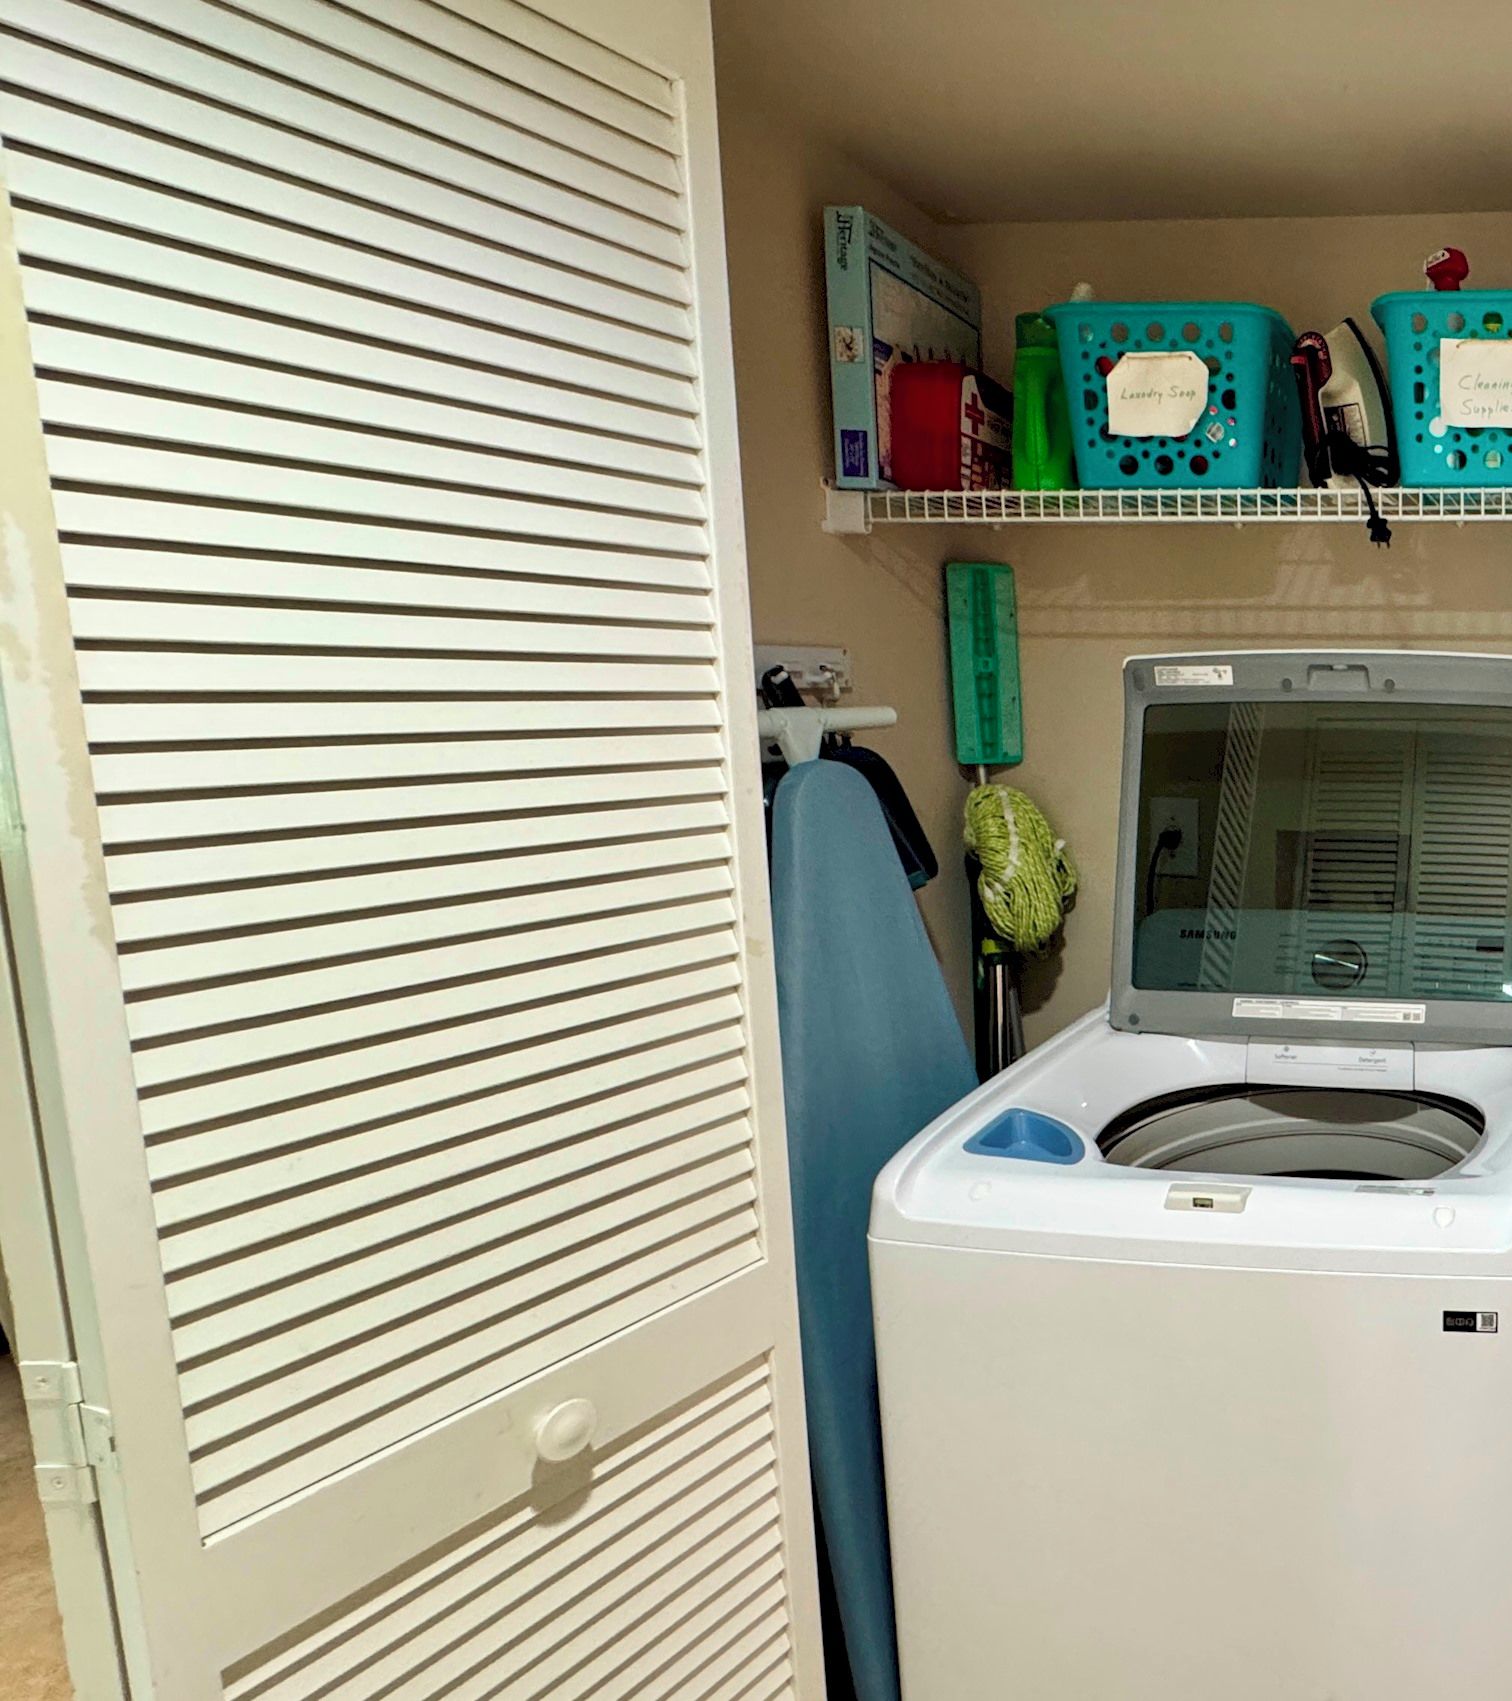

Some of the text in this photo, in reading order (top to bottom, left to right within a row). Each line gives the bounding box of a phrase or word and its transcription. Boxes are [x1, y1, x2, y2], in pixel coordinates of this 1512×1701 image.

[1120, 385, 1197, 405] Laundry Soap
[1179, 929, 1237, 940] SAMSUNG
